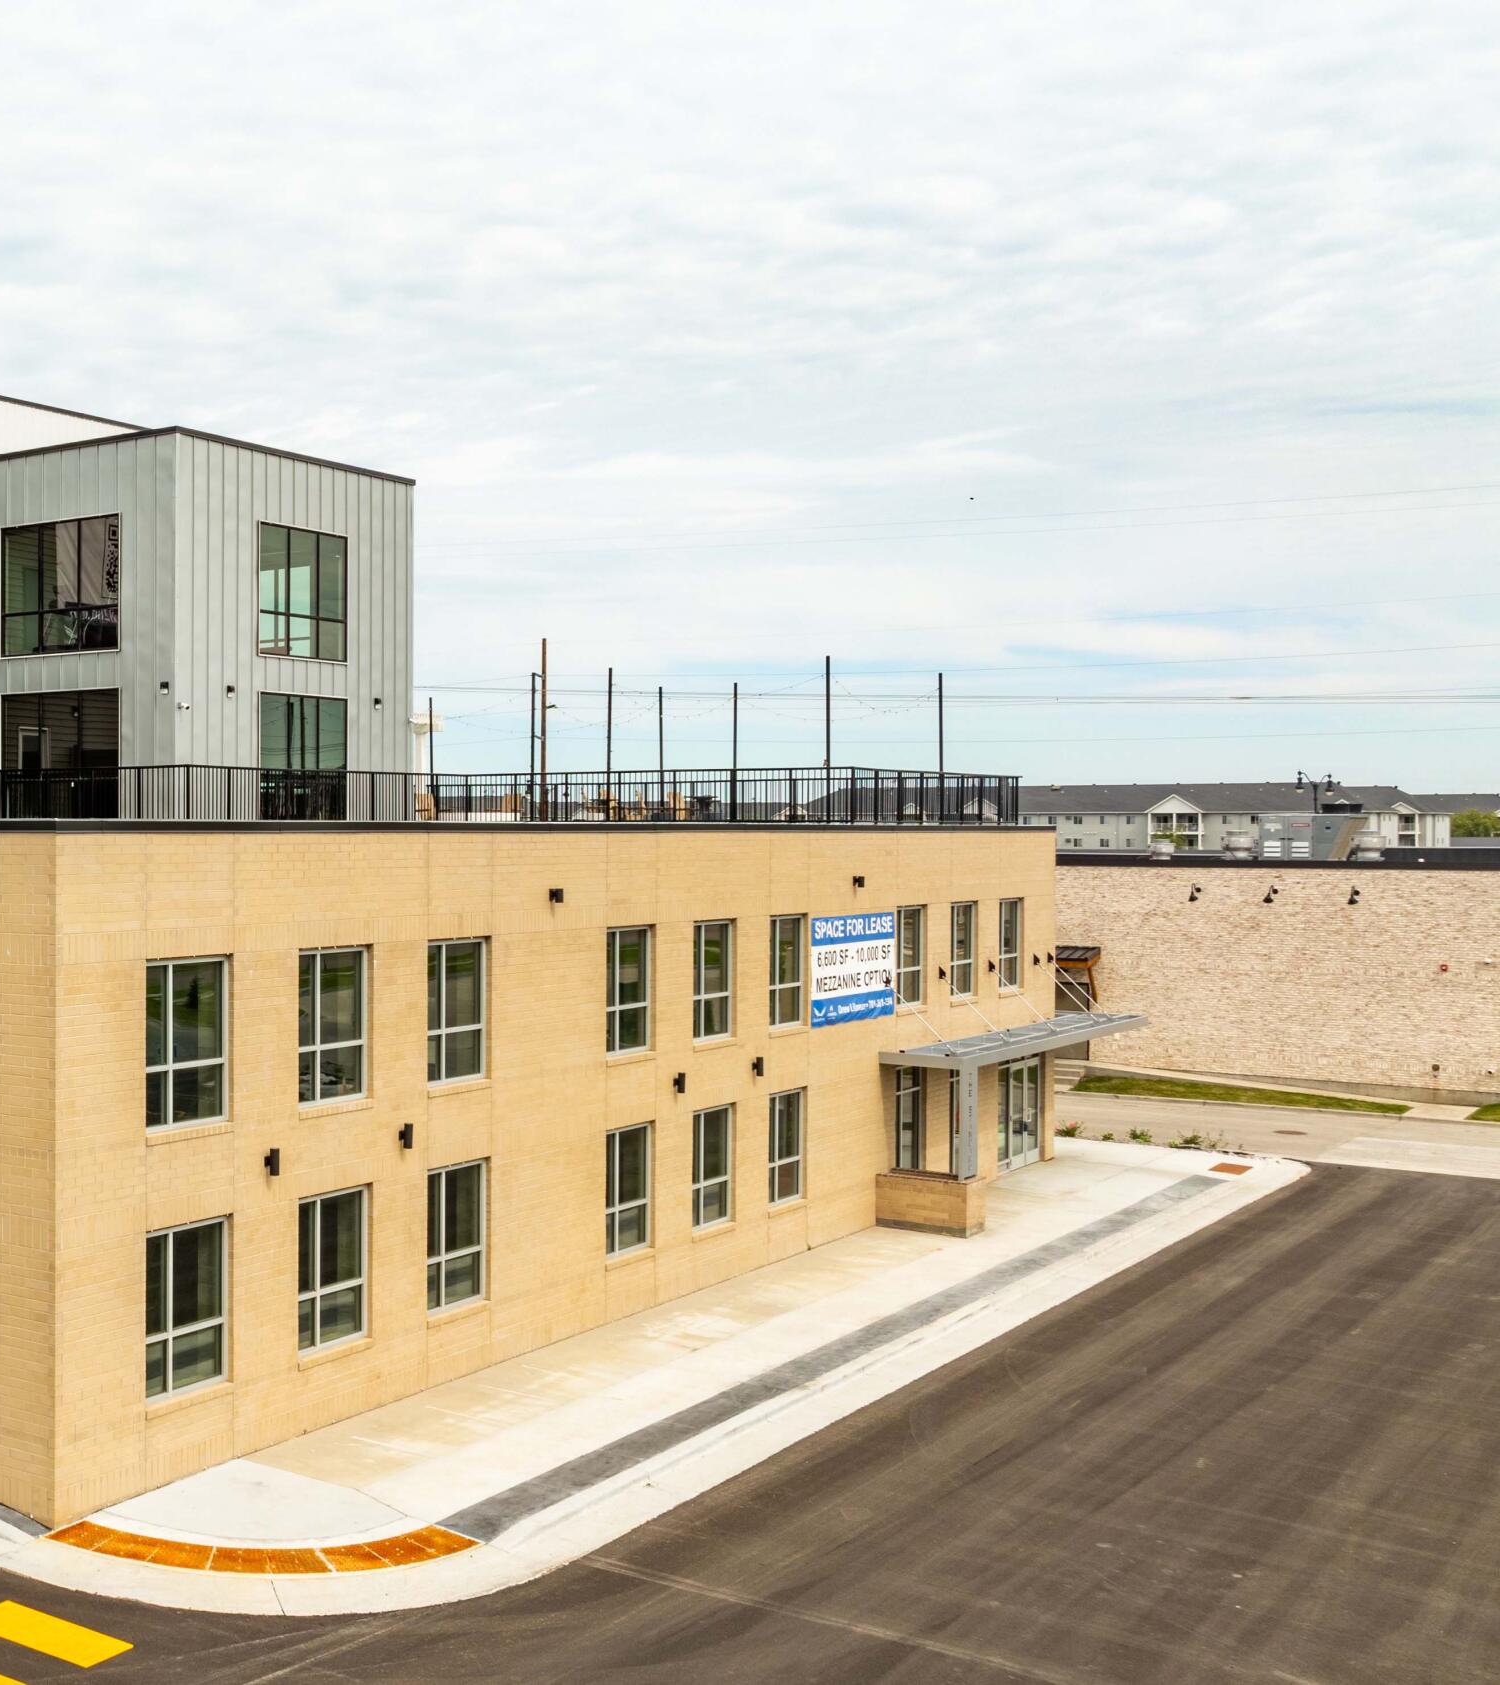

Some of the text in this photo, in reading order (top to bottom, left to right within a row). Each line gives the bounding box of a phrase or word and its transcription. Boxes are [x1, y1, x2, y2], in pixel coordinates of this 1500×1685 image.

[814, 916, 893, 939] SPACE FOR LEASE
[839, 949, 848, 965] SF
[881, 944, 891, 960] SF
[816, 972, 861, 993] MEZZANINE
